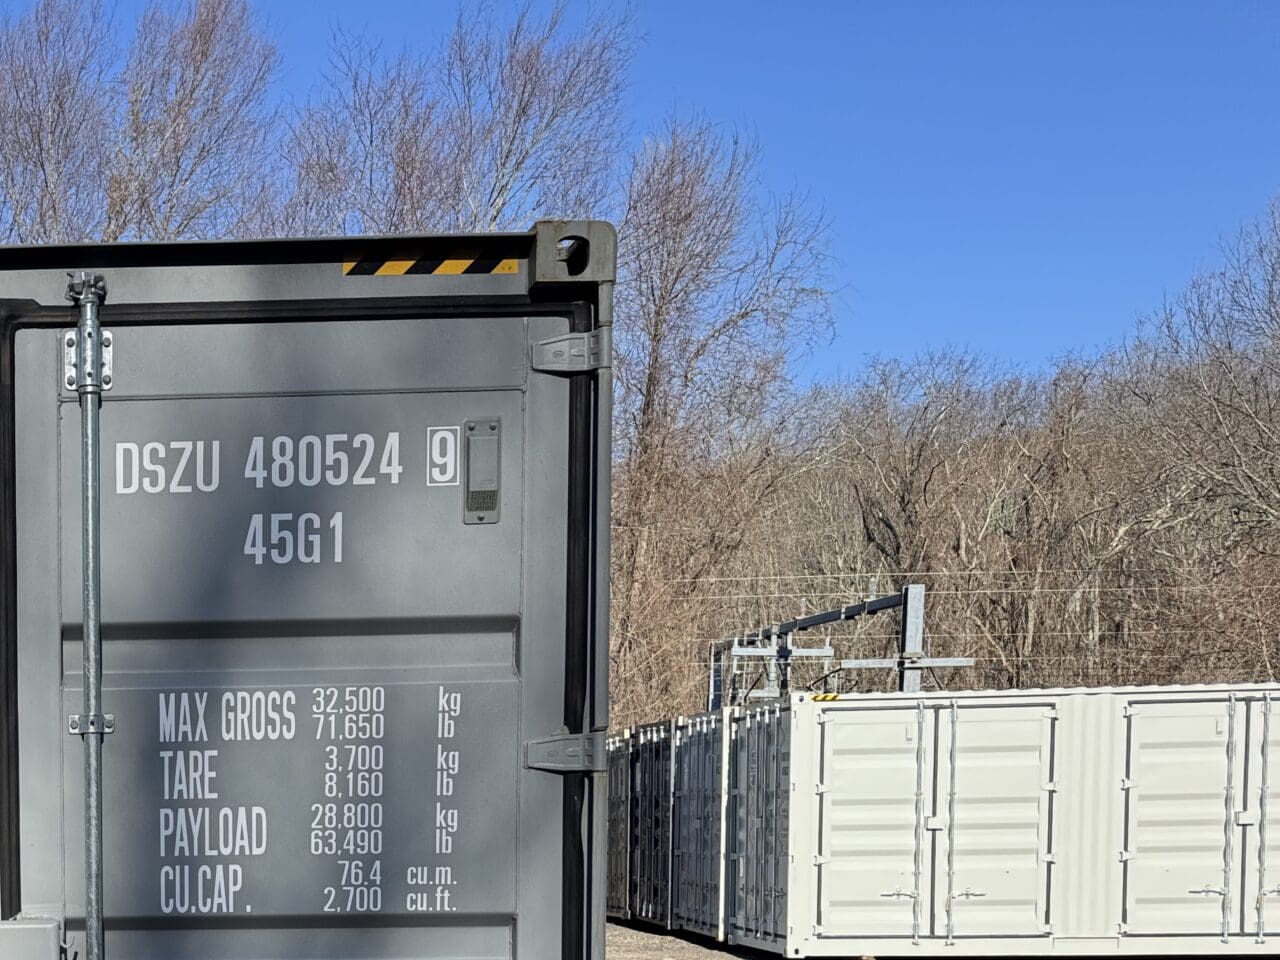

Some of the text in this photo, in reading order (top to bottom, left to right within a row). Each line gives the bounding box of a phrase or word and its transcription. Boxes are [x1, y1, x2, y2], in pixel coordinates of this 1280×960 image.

[115, 430, 456, 494] DSZU 480524 9
[243, 512, 343, 565] 45G1
[312, 685, 461, 716] 32,500 kg
[159, 690, 296, 742] MAX GROSS
[312, 712, 455, 740] 71,650 lb
[325, 744, 459, 774] 3,700 kg
[159, 749, 218, 800] TARE
[324, 771, 453, 798] 8,160 lb
[159, 806, 267, 857] PAYLOAD
[311, 802, 458, 832] 28,800 kg
[311, 829, 452, 856] 63,490 lb
[337, 860, 457, 886] 76.4 cu.m.
[323, 887, 457, 913] 2,700 cu.ft.
